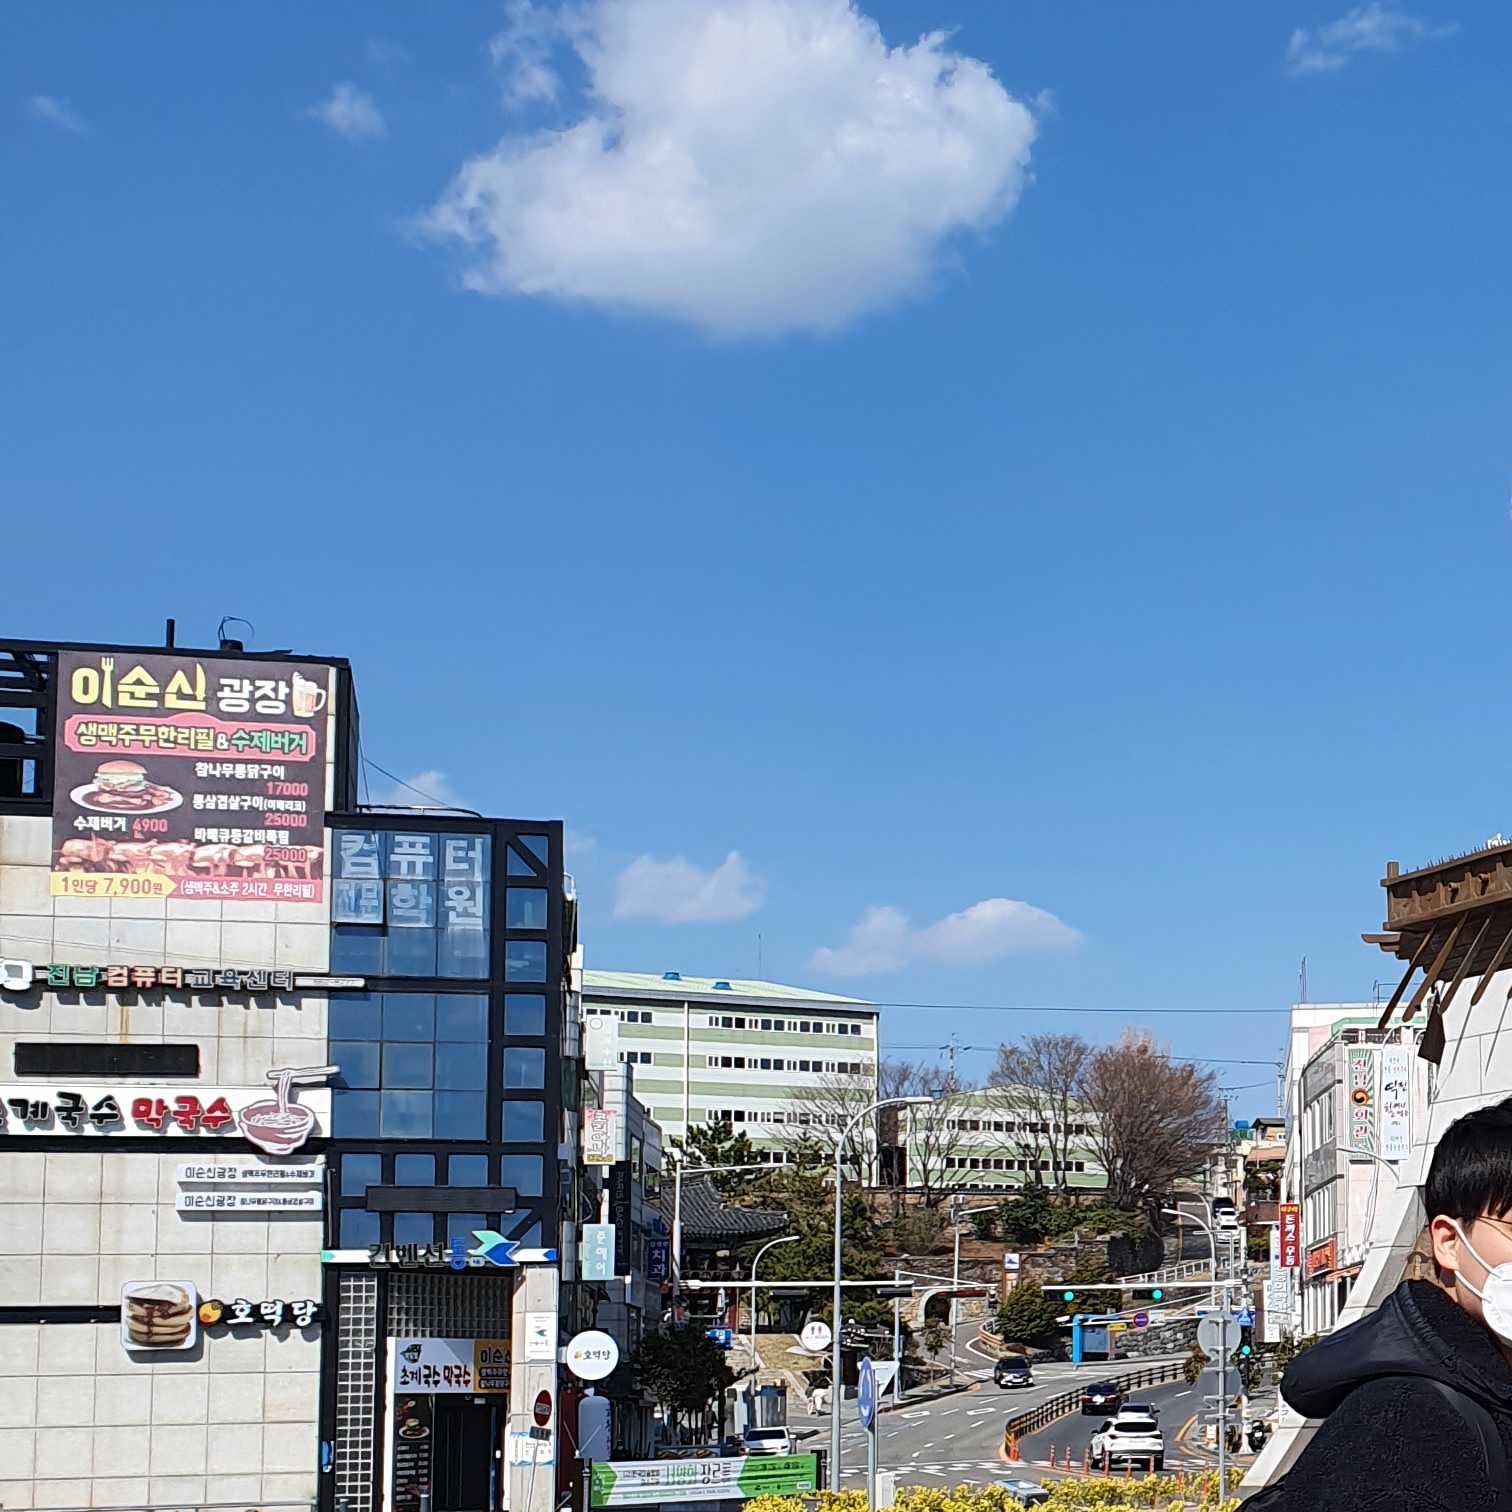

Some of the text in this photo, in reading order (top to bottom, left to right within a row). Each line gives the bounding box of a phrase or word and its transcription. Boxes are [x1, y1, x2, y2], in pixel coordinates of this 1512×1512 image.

[71, 656, 290, 715] 이순신 광장
[195, 762, 285, 780] 참나무통닭구이
[266, 781, 309, 796] 17000
[73, 816, 168, 833] 수제버거 4900
[264, 814, 308, 827] 25000
[264, 848, 307, 862] 25000
[340, 834, 485, 881] 컴퓨터
[61, 877, 164, 896] 1인당 7,900원
[242, 882, 268, 895] 2시간
[106, 964, 183, 988] 컴퓨터
[190, 968, 294, 991] 교육센터
[0, 1092, 232, 1129] 계국수 막국수
[185, 1167, 237, 1179] 이순신광장
[184, 1195, 236, 1207] 이순신광장
[651, 1249, 667, 1277] 치과
[227, 1302, 317, 1327] 호떡당
[400, 1365, 441, 1388] 초계국수
[443, 1365, 471, 1388] 막국수
